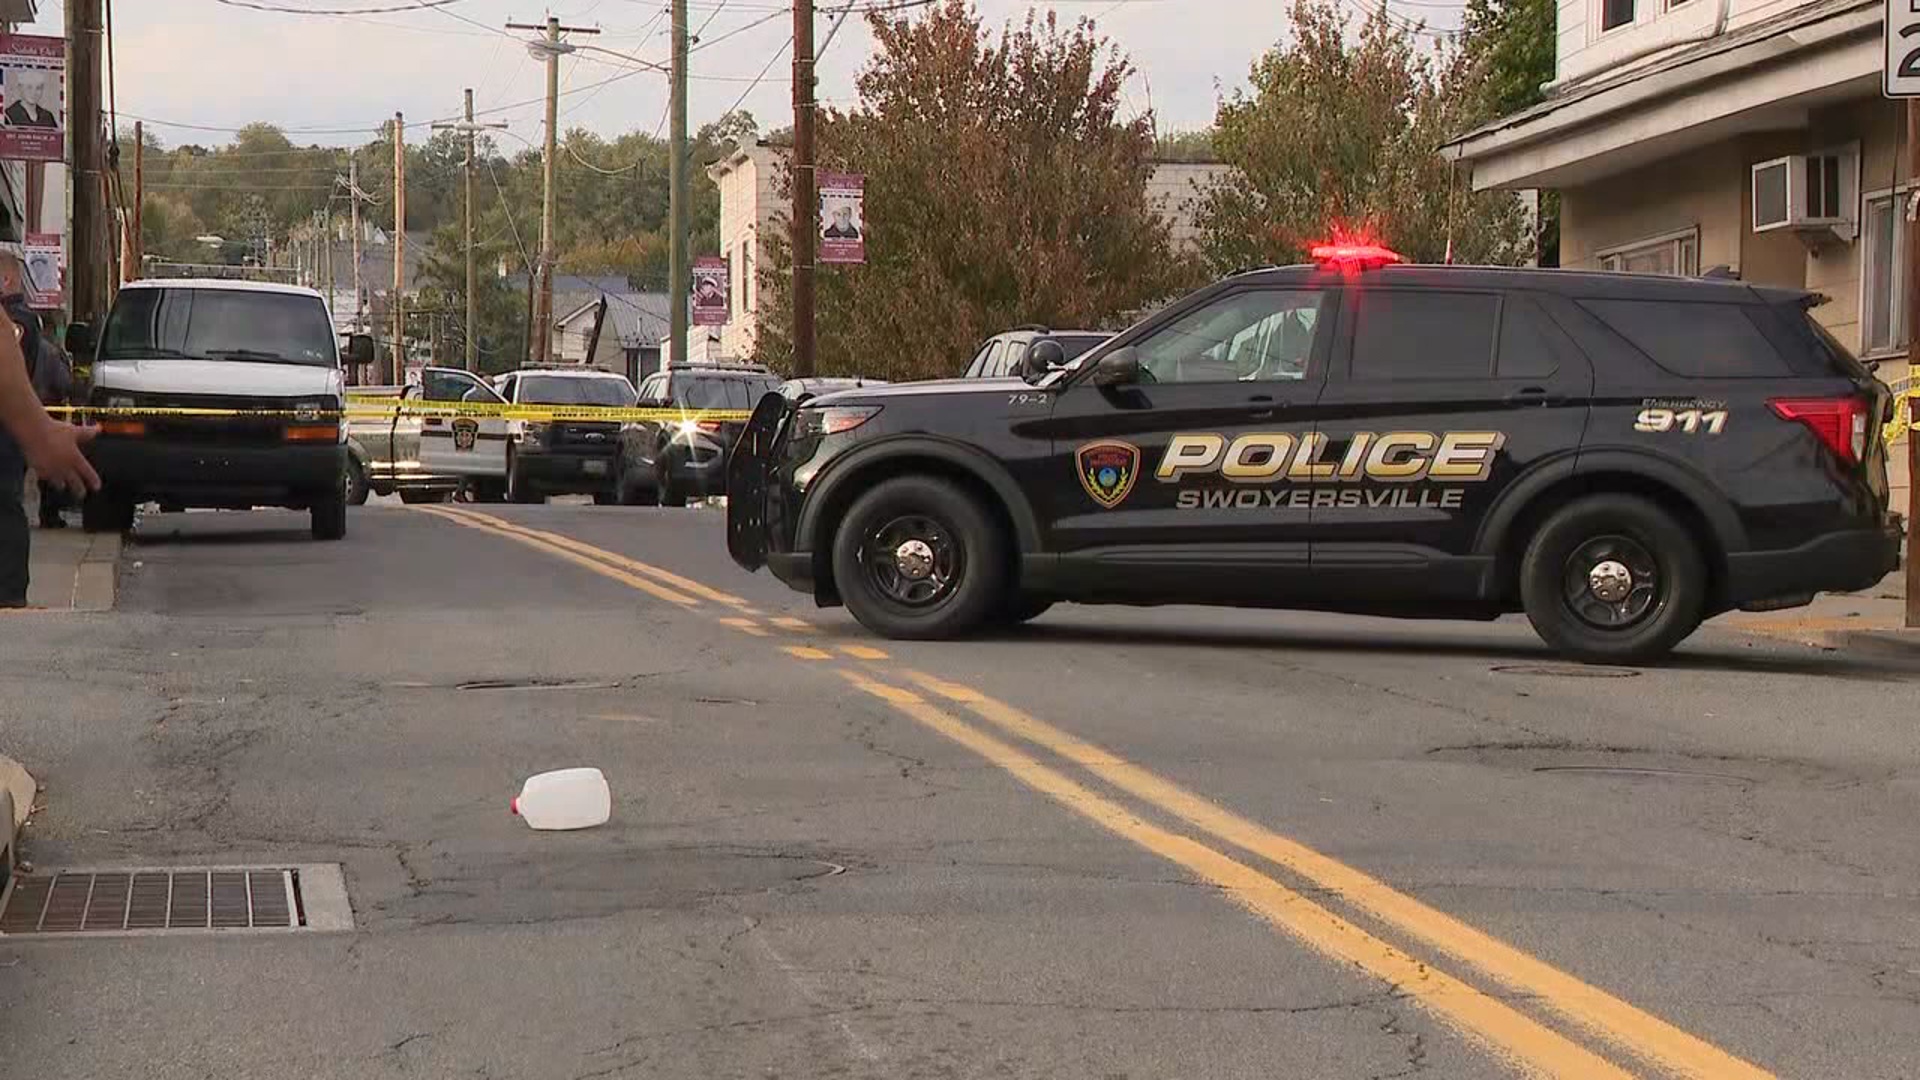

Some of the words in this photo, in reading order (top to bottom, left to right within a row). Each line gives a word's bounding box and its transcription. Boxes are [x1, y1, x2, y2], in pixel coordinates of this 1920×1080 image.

[1008, 393, 1047, 405] 79-2
[1633, 408, 1728, 434] 911
[1154, 432, 1506, 483] POLICE
[1176, 489, 1465, 509] SWOYERSVILLE
